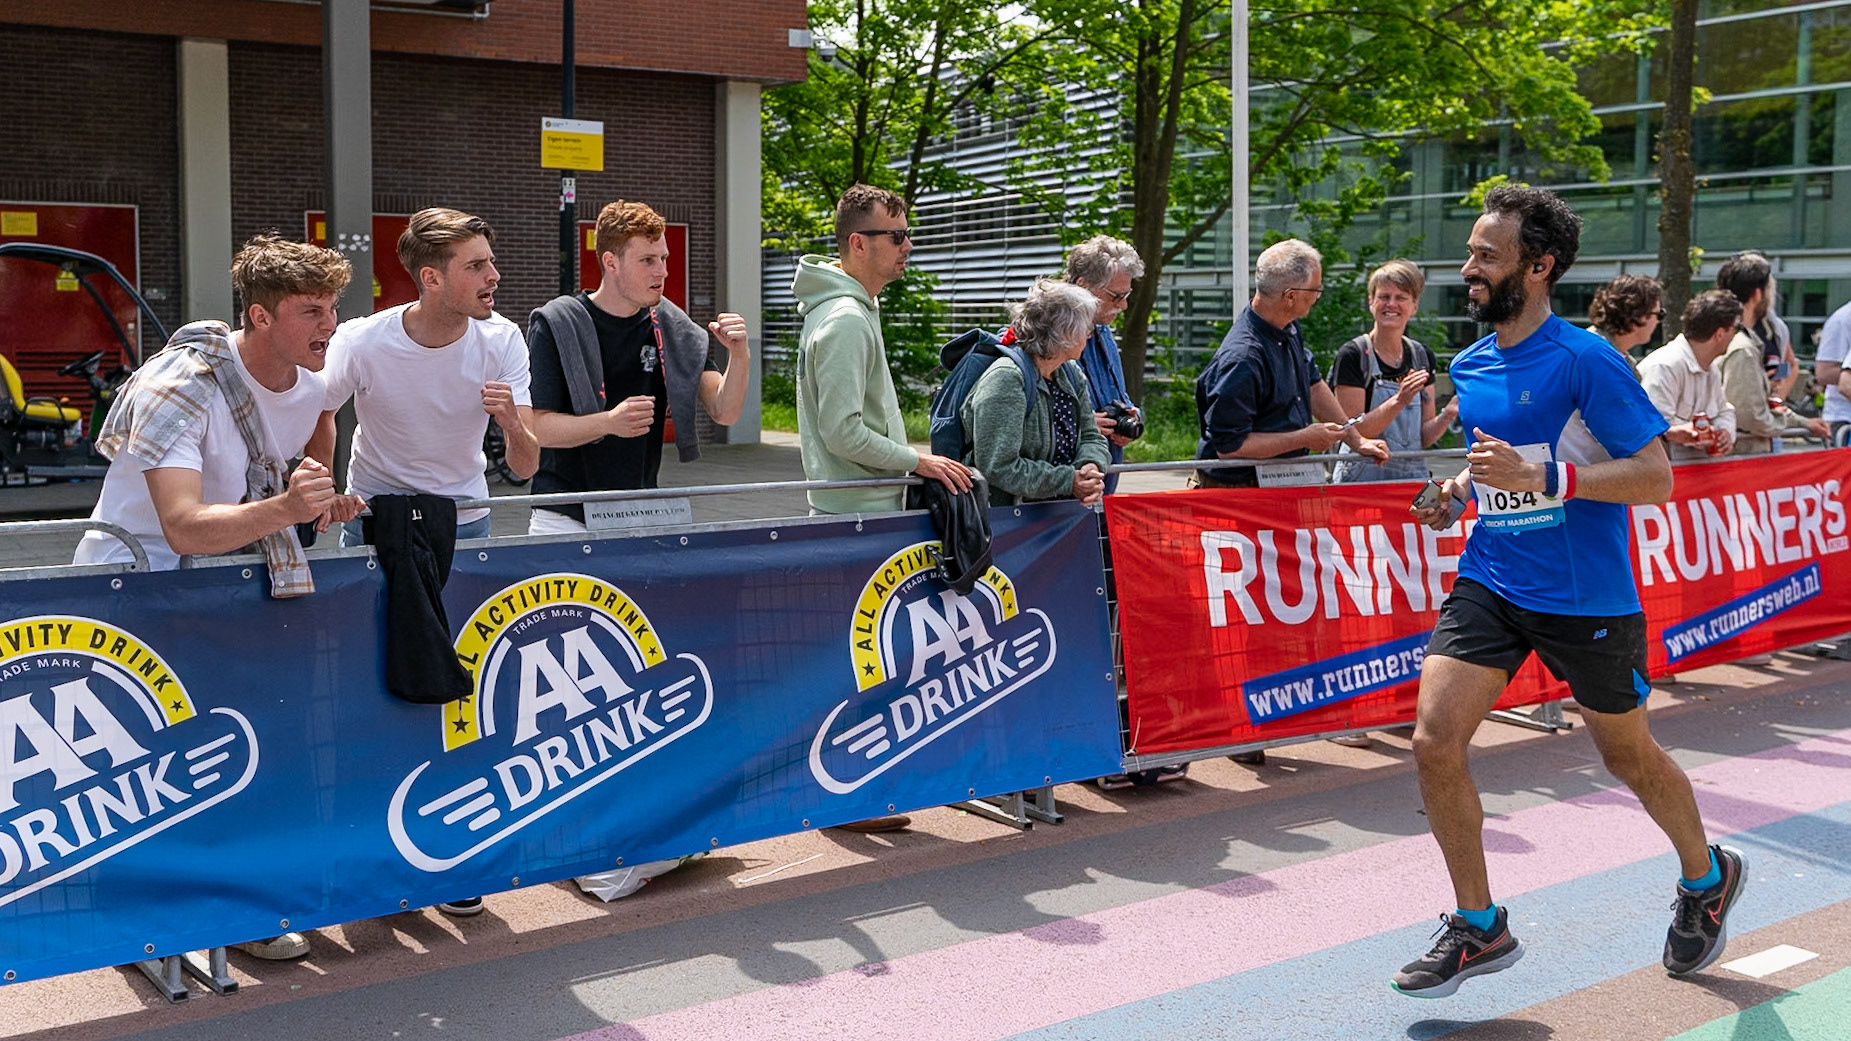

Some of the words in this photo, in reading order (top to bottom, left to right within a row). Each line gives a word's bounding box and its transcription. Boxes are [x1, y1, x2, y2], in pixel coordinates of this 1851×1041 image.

[1486, 491, 1538, 511] 1054
[1507, 514, 1554, 527] MARATHON
[1631, 479, 1847, 587] RUNNER'S
[474, 580, 579, 642] ACTIVITY
[589, 583, 650, 641] DRINK
[856, 607, 877, 652] ALL
[873, 545, 941, 600] ACTIVI
[901, 573, 928, 594] TRADE
[1200, 519, 1478, 628] RUNNE
[1665, 566, 1821, 658] www.runnersweb.nl
[0, 623, 73, 658] VITY
[89, 628, 173, 693] DRINK
[513, 612, 547, 636] TRADE
[550, 608, 584, 619] MARK
[905, 588, 994, 689] AA
[0, 661, 31, 682] ADE
[37, 658, 81, 669] MARK
[512, 625, 635, 747] AA
[888, 639, 1018, 743] DRINK
[1249, 643, 1428, 717] www.runners
[0, 676, 152, 813] AA
[493, 690, 665, 812] DRINK
